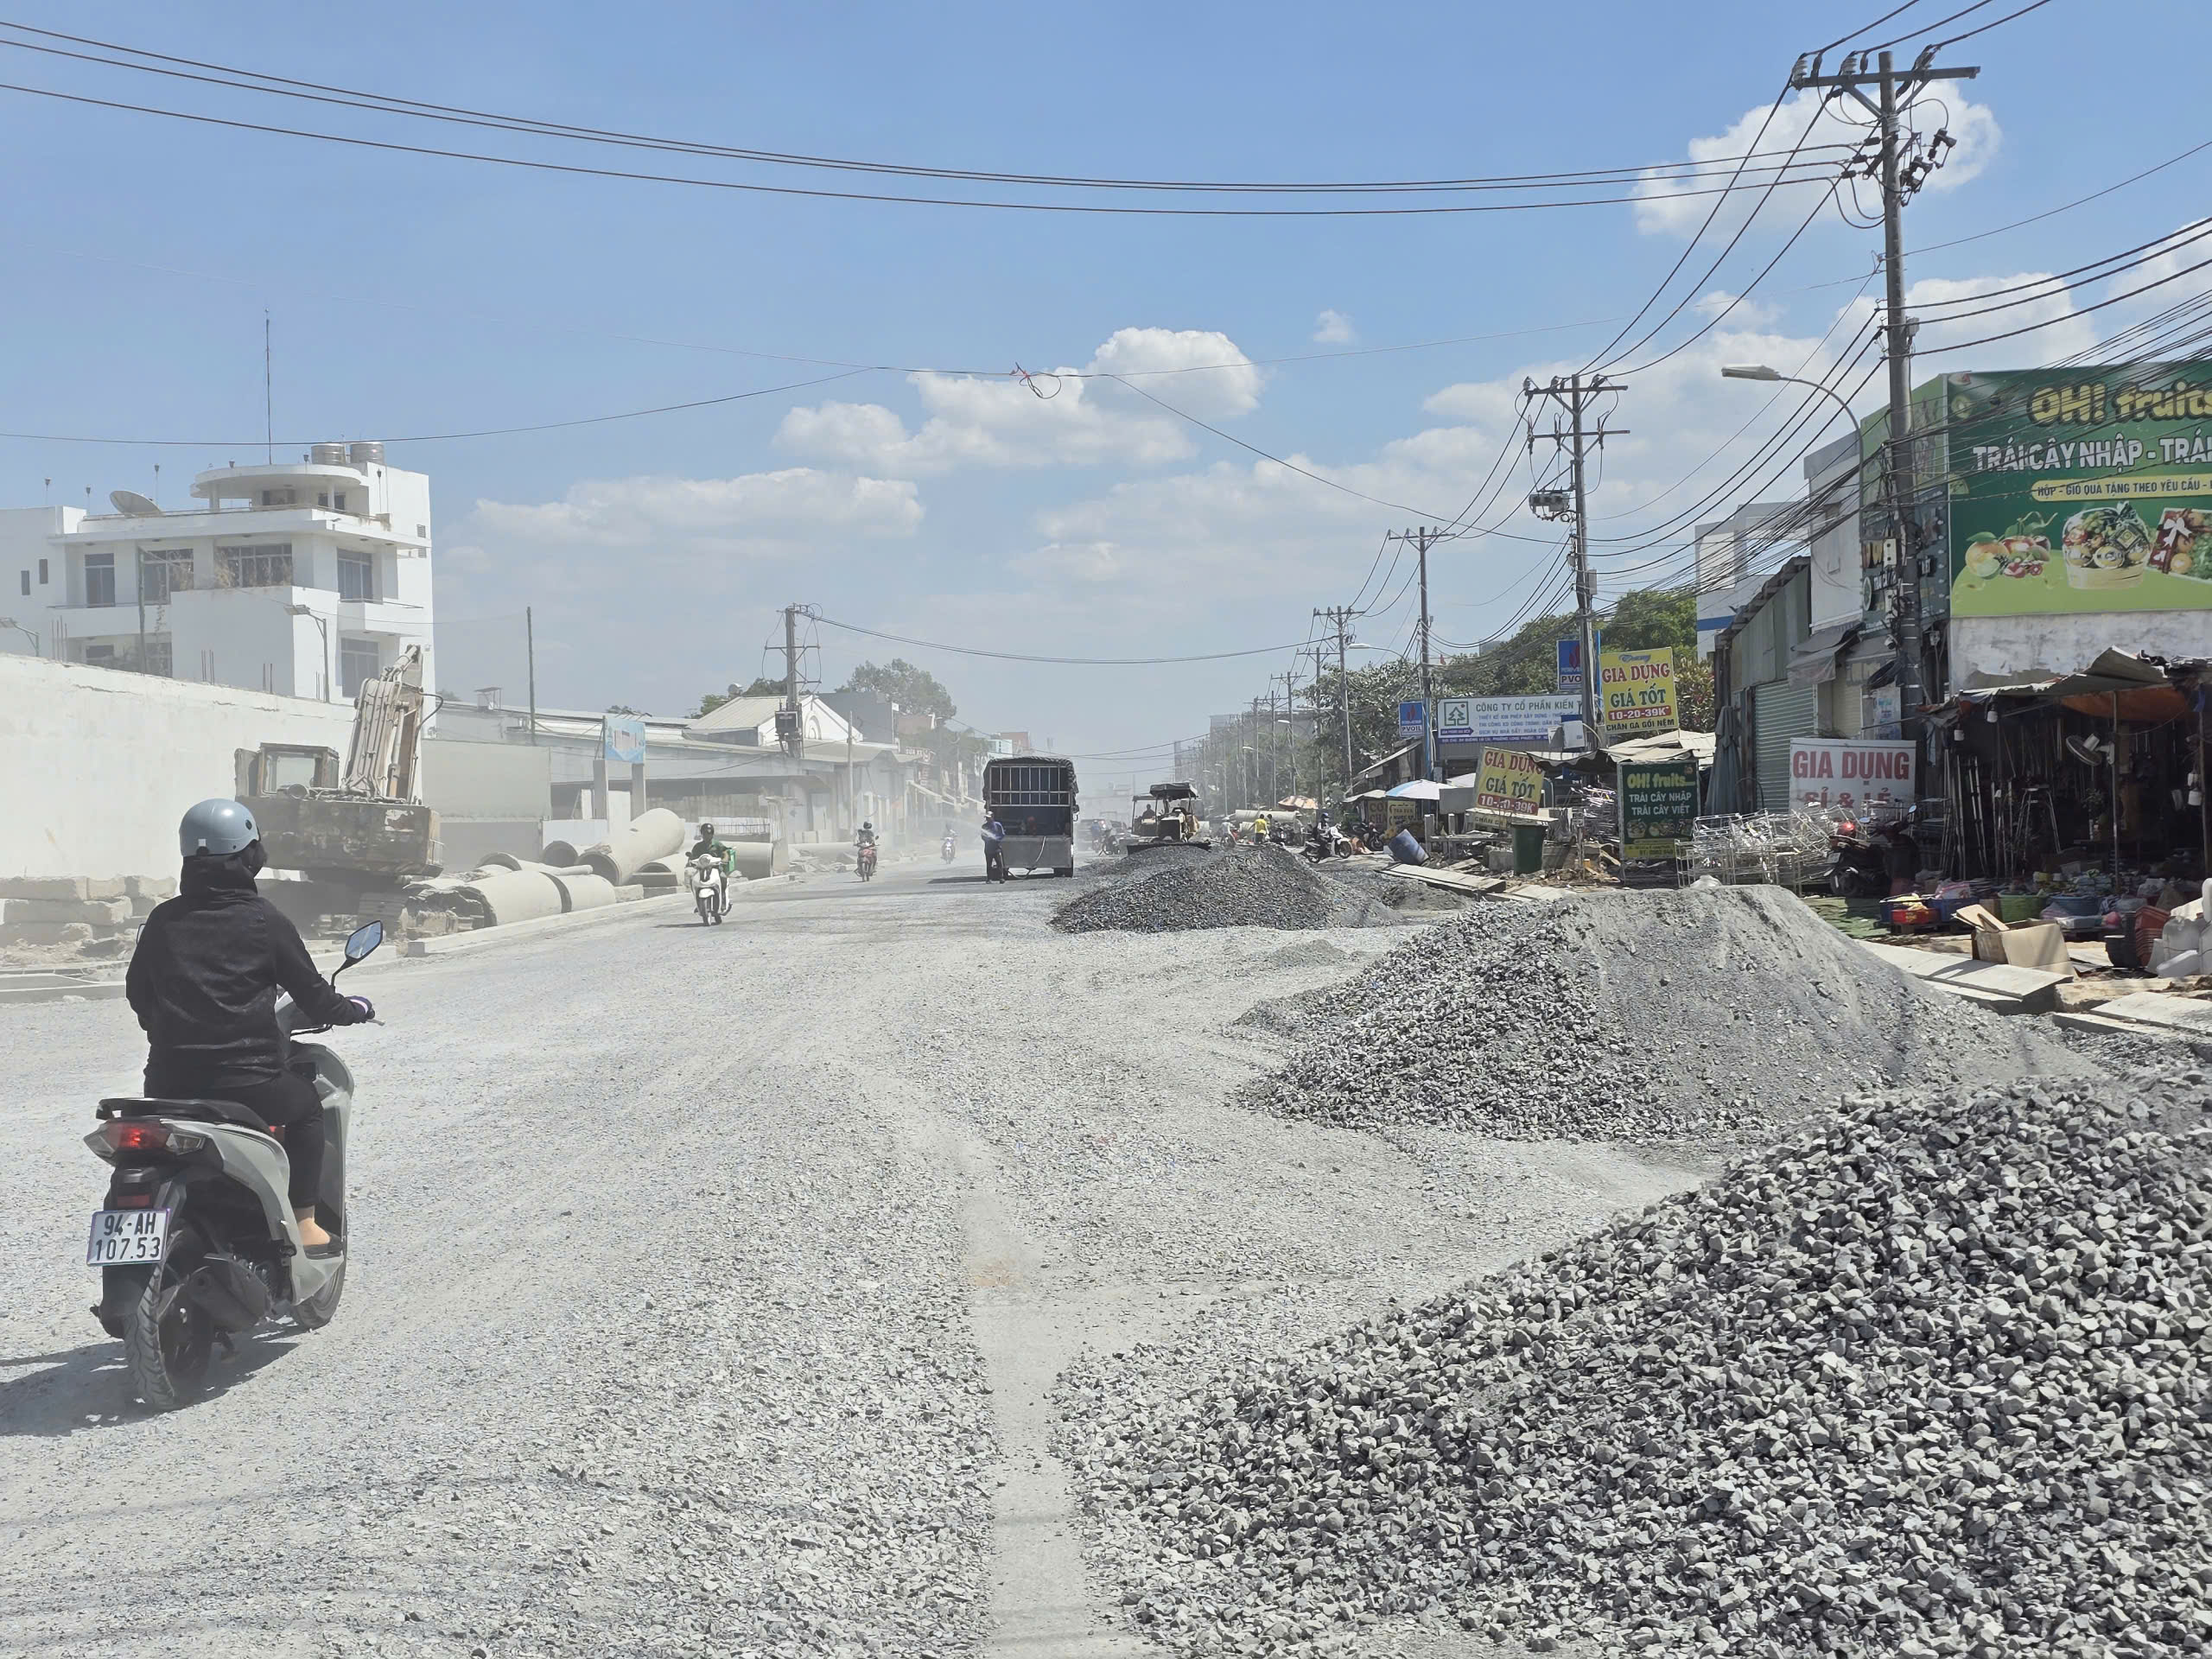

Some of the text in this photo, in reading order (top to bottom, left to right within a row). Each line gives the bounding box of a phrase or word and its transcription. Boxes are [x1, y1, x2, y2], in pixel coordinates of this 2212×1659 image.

[2031, 383, 2107, 424] OH!
[1973, 435, 2024, 471] TRÁI
[2029, 437, 2075, 470] CÂY
[2080, 433, 2143, 473] NHẬP
[2133, 480, 2158, 493] THEO
[2160, 479, 2177, 492] YÊU
[1602, 663, 1670, 683] GIA DỤNG
[1611, 683, 1666, 708] GIÁ TỐT
[1476, 702, 1498, 712] CÔNG
[1502, 702, 1512, 712] TY
[1484, 750, 1505, 768] GIA
[1793, 750, 1910, 785] GIA DỤNG
[1486, 775, 1535, 798] GIÁ TỐT
[1627, 772, 1650, 789] OH!
[1629, 791, 1649, 803] TRÁI
[1650, 791, 1667, 802] CÂY
[1631, 804, 1651, 816] TRÁI
[1653, 804, 1669, 815] CÂY
[103, 1212, 157, 1236] 94-AH
[95, 1236, 161, 1262] 107.53
